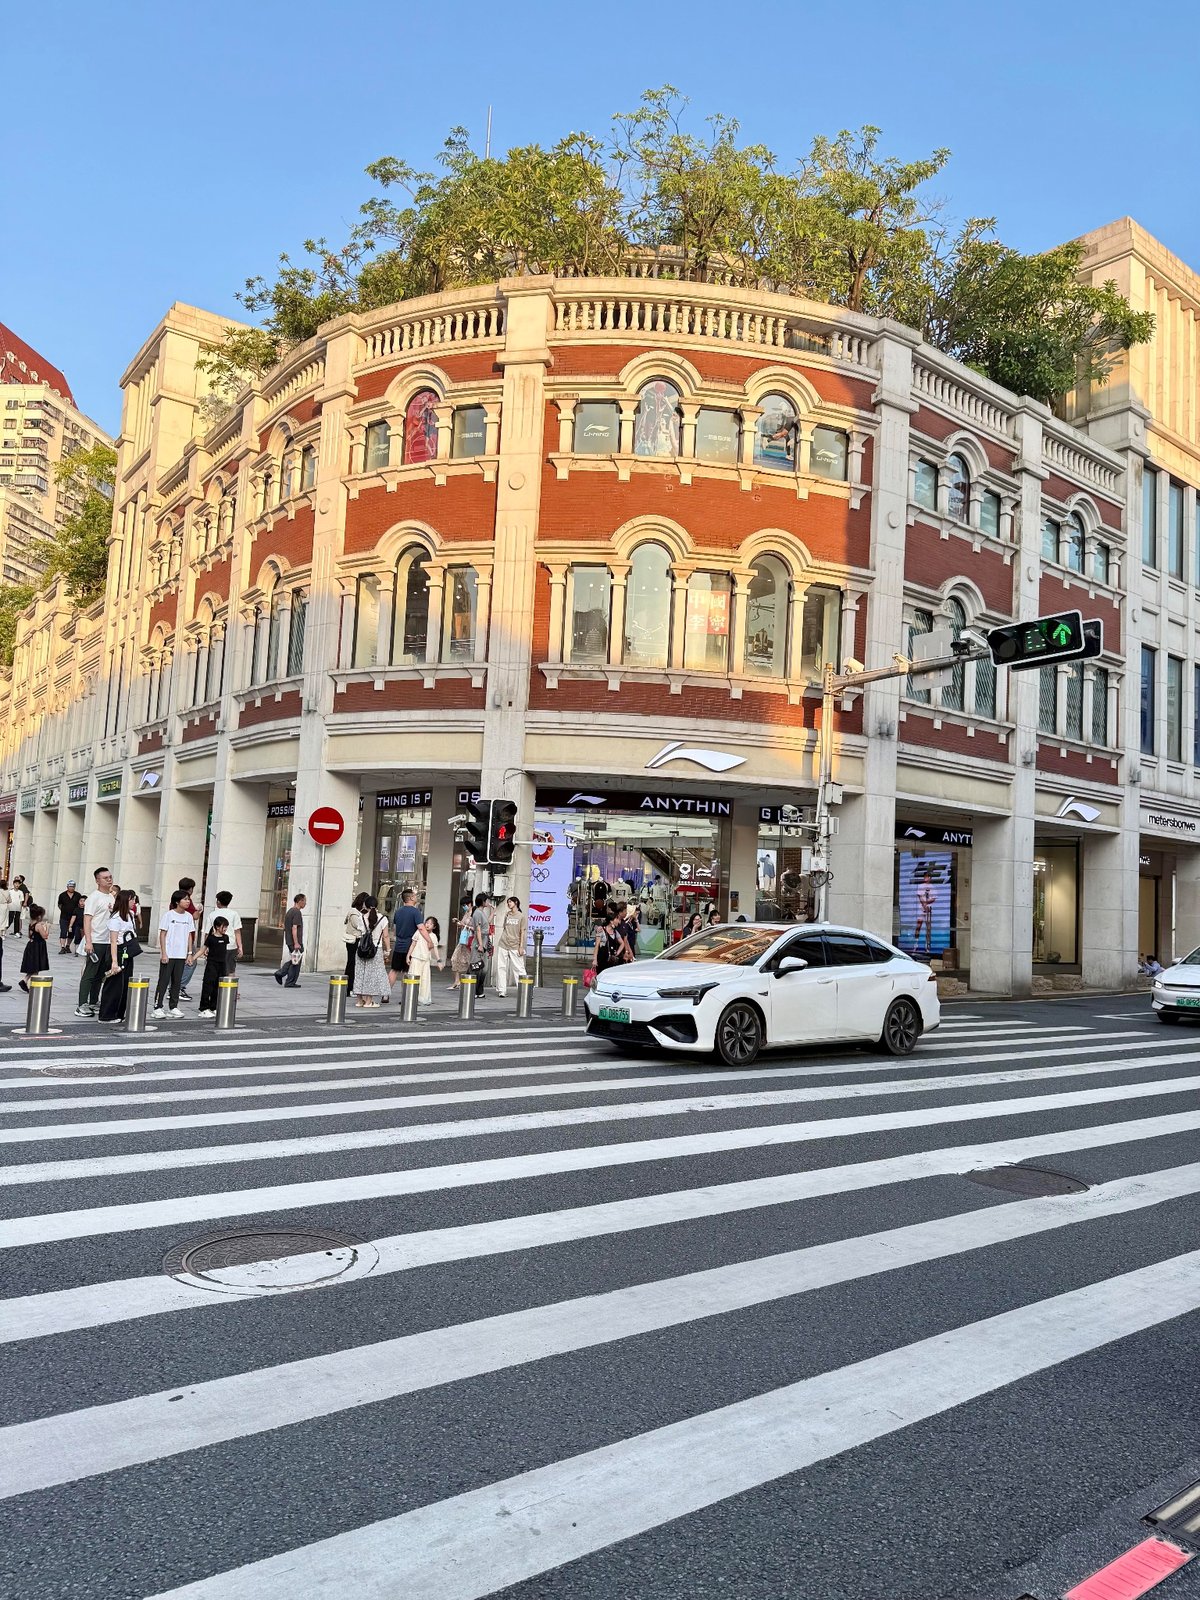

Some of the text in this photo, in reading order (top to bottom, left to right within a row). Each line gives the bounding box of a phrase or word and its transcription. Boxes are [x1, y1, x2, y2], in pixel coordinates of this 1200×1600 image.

[377, 794, 407, 807] THING
[410, 793, 421, 805] IS
[640, 796, 730, 815] ANYTHIN
[1147, 814, 1197, 831] metersbonwe
[942, 831, 974, 845] ANYT
